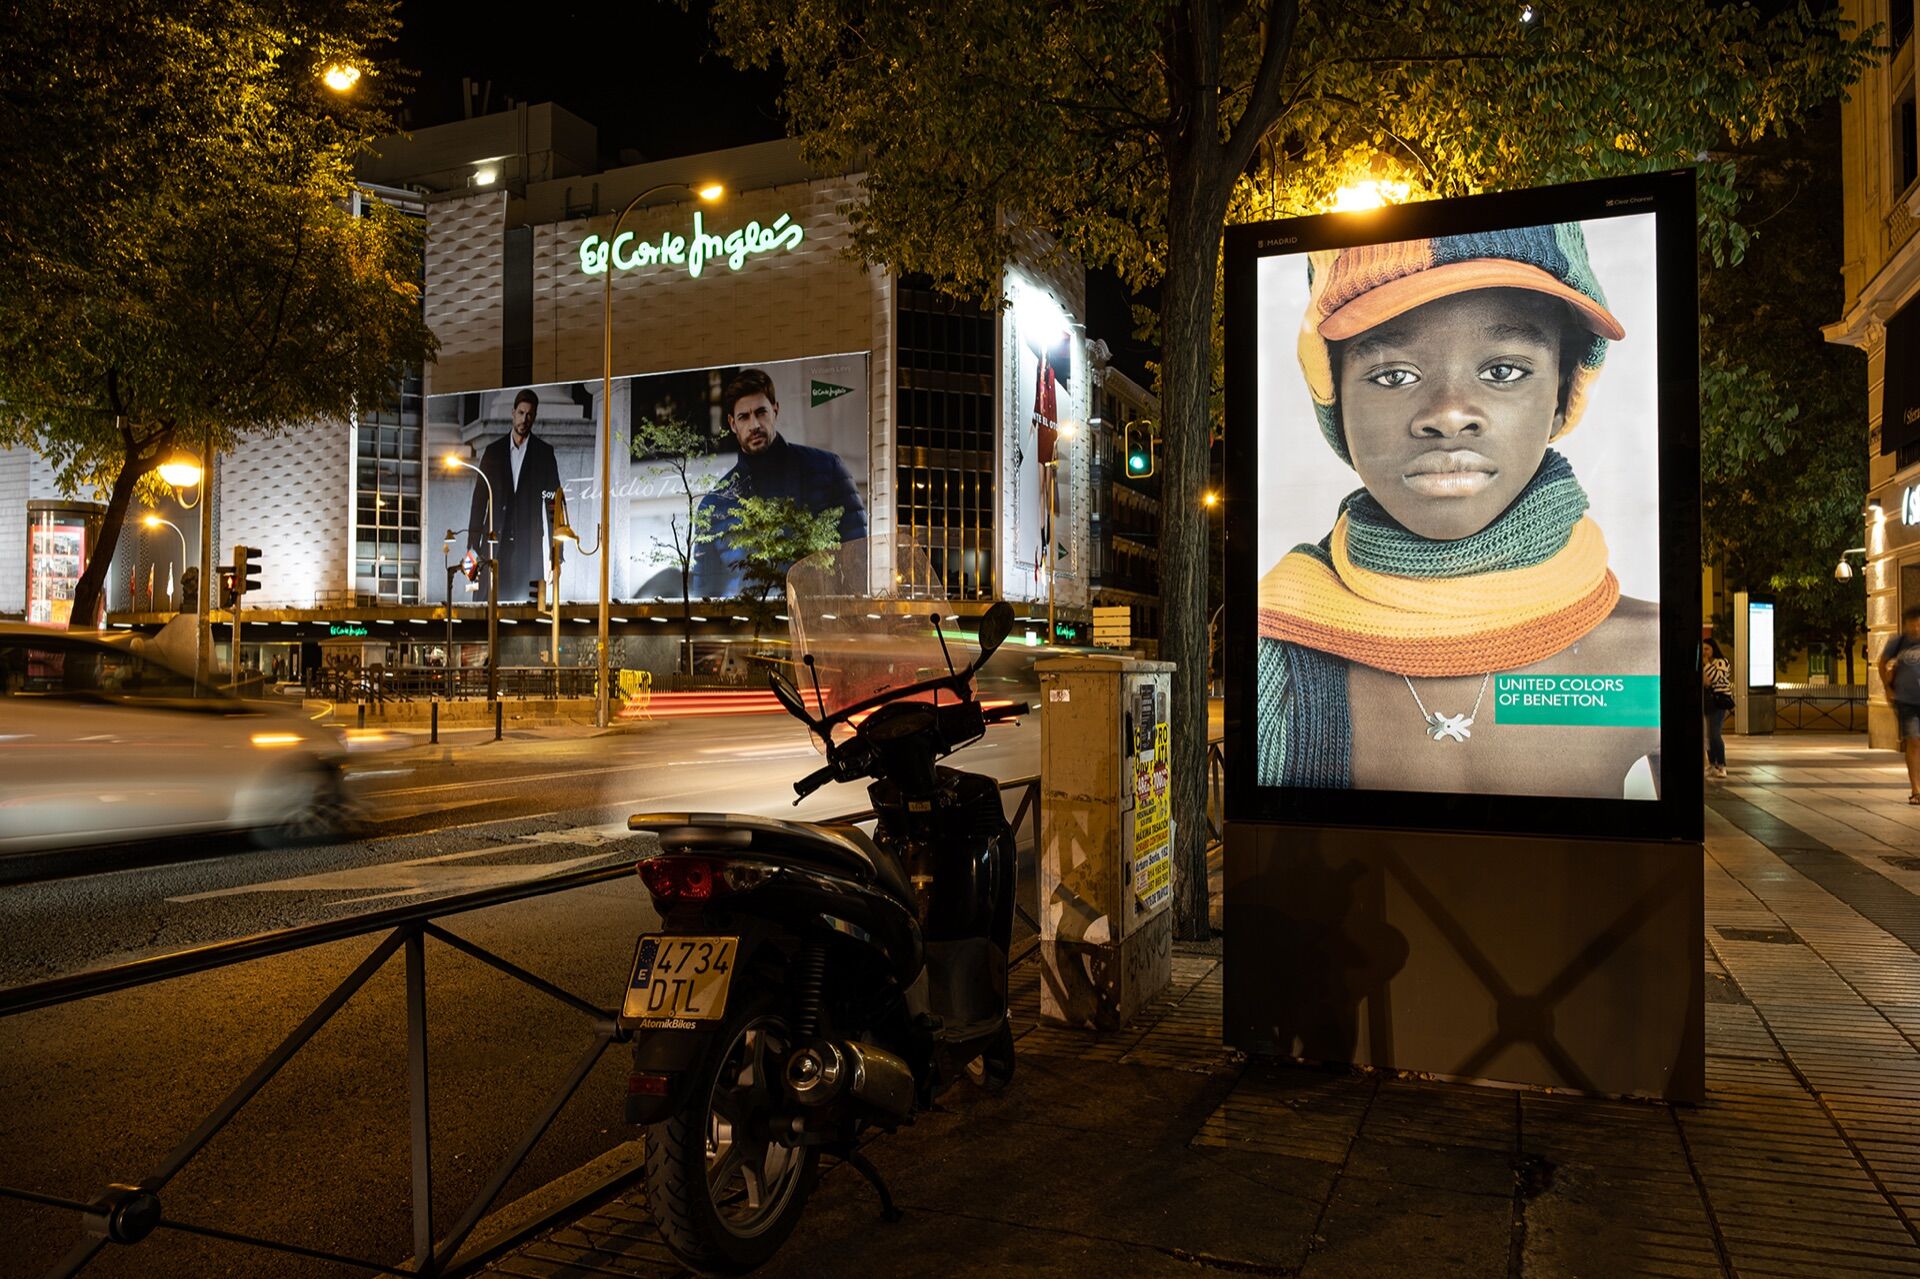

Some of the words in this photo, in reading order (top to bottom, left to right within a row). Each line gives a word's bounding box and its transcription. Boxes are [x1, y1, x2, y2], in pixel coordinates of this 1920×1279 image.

[579, 234, 610, 275] El
[611, 231, 685, 270] Corte
[688, 211, 804, 278] Inglés
[1266, 236, 1298, 247] MADRID
[1498, 678, 1556, 692] UNITED
[1559, 678, 1625, 692] COLORS
[1498, 693, 1520, 706] OF
[1523, 694, 1608, 708] BENETTON.
[657, 942, 729, 975] 4734
[638, 968, 648, 980] E
[647, 979, 700, 1013] DTL
[640, 1019, 697, 1030] AtomikBikes
